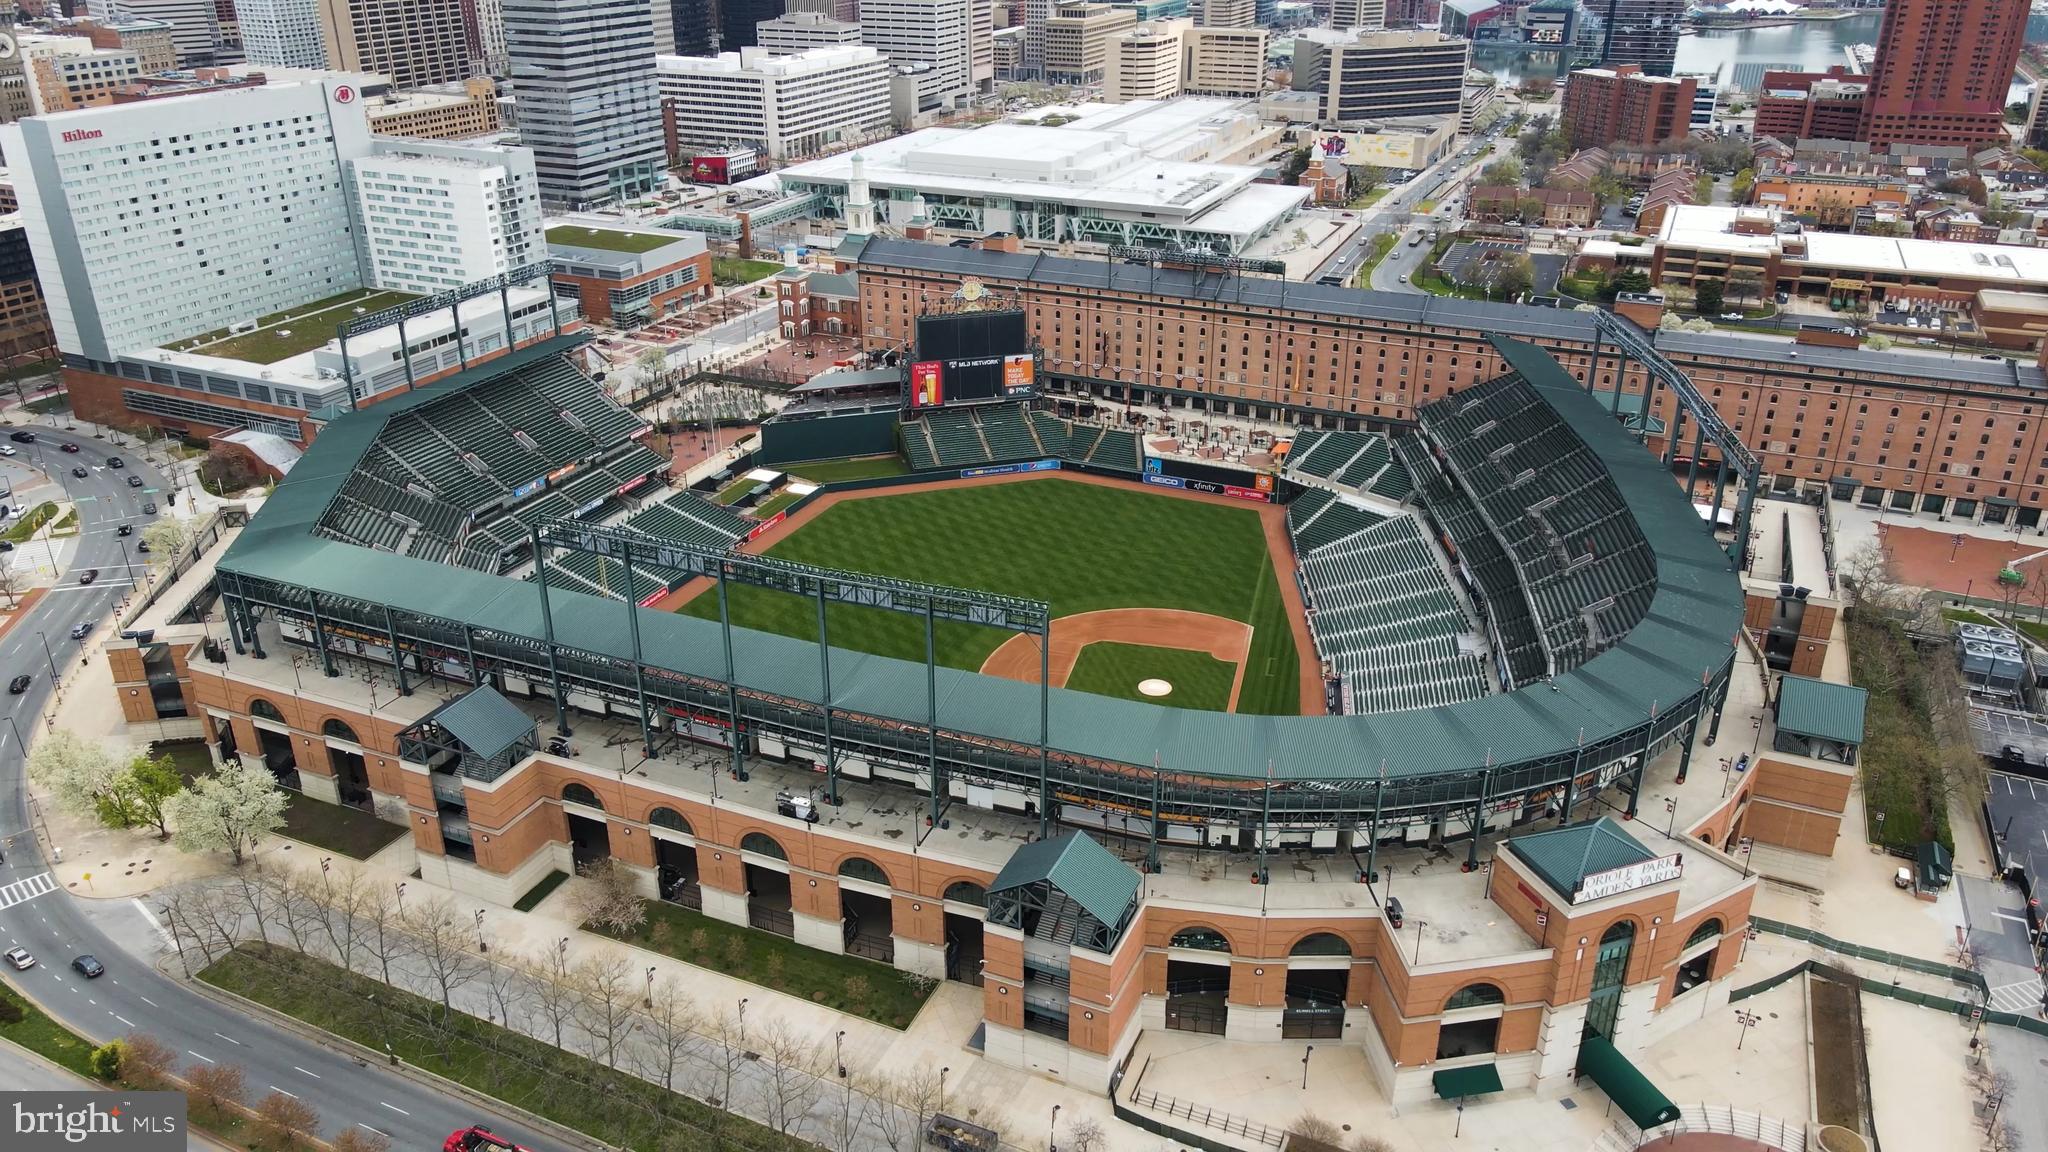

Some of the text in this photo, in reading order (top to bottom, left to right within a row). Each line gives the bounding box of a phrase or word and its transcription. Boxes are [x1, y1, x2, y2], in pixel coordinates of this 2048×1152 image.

[61, 128, 103, 143] Hilton
[971, 359, 999, 367] NETWORK
[1015, 386, 1031, 394] PNC
[1150, 475, 1179, 486] GEICO
[1193, 482, 1216, 492] xfinity
[1585, 858, 1673, 888] ORIOLE PARK
[1639, 869, 1680, 885] YARDS
